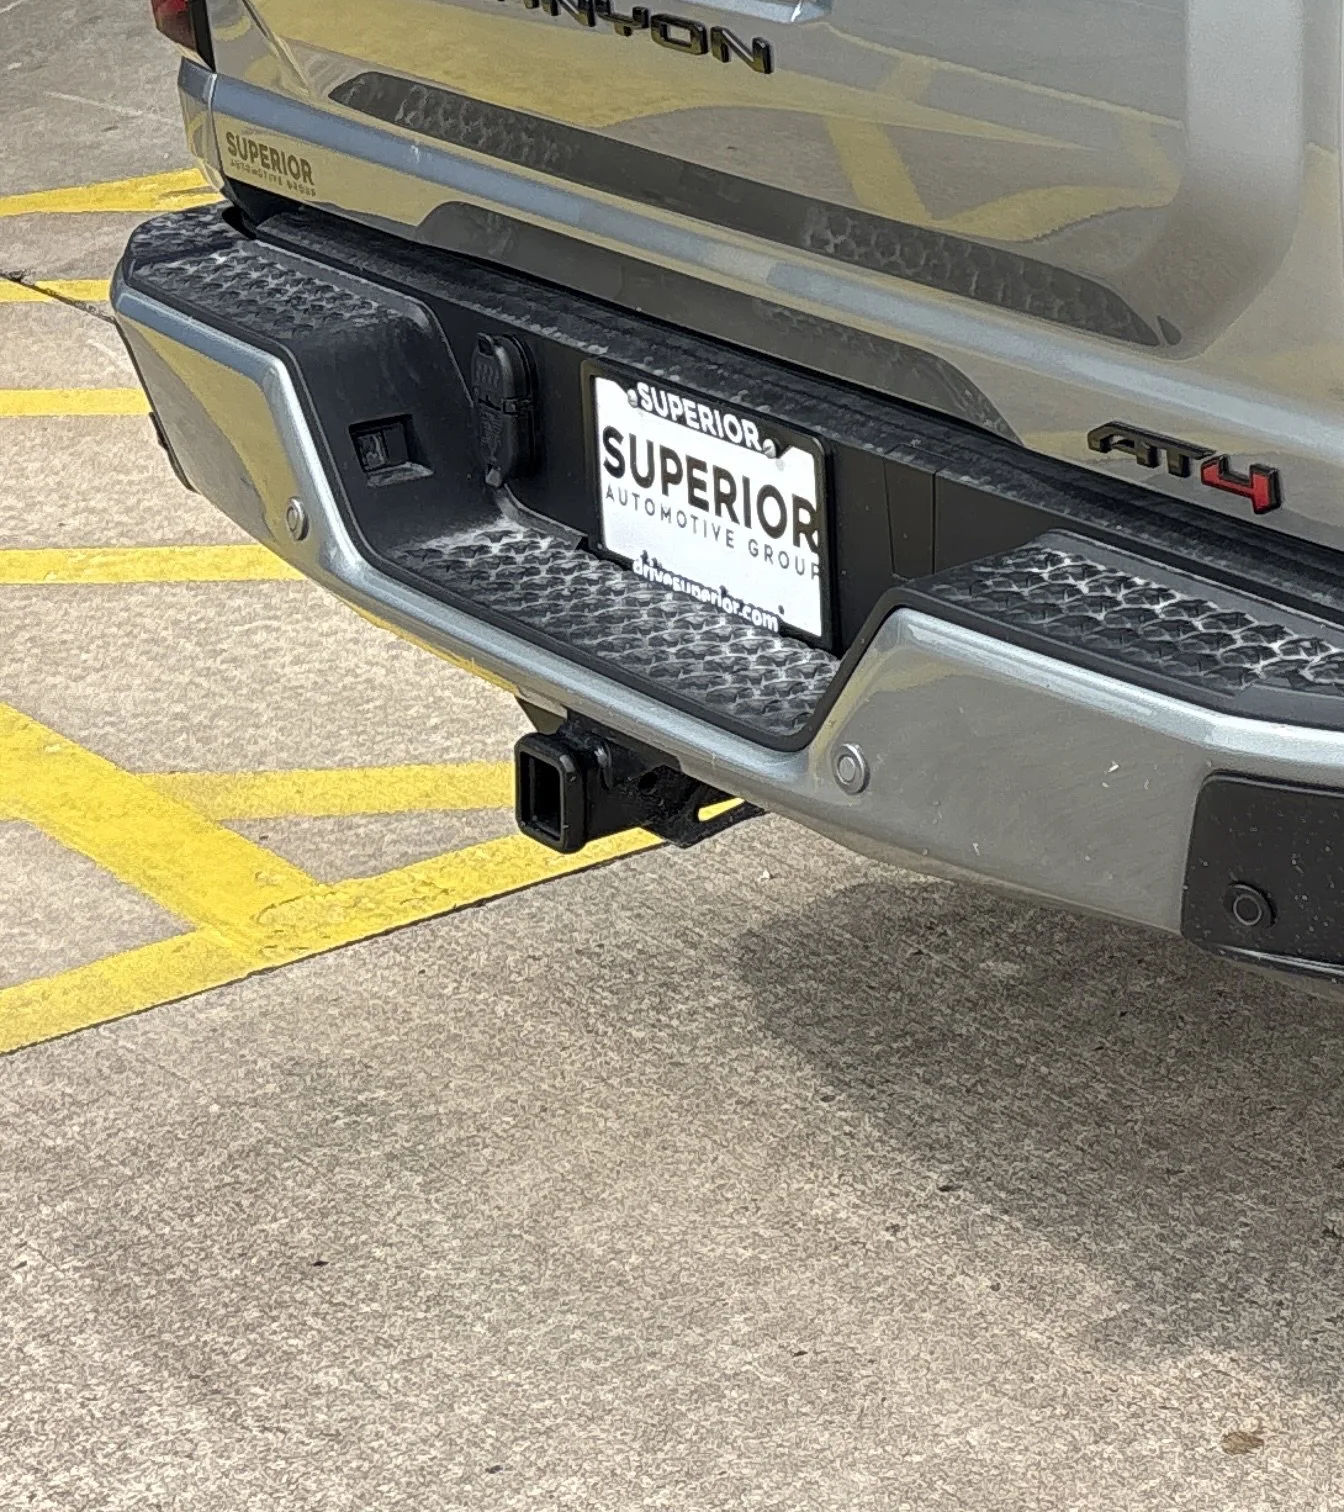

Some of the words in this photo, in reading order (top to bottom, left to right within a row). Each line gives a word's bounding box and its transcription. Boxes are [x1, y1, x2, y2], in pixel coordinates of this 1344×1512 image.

[226, 131, 315, 186] SUPERIOR
[636, 382, 763, 452] SUPERIOR
[602, 425, 820, 554] SUPERIOR
[1087, 420, 1282, 515] AT4
[605, 484, 734, 549] AUTOMOTIVE
